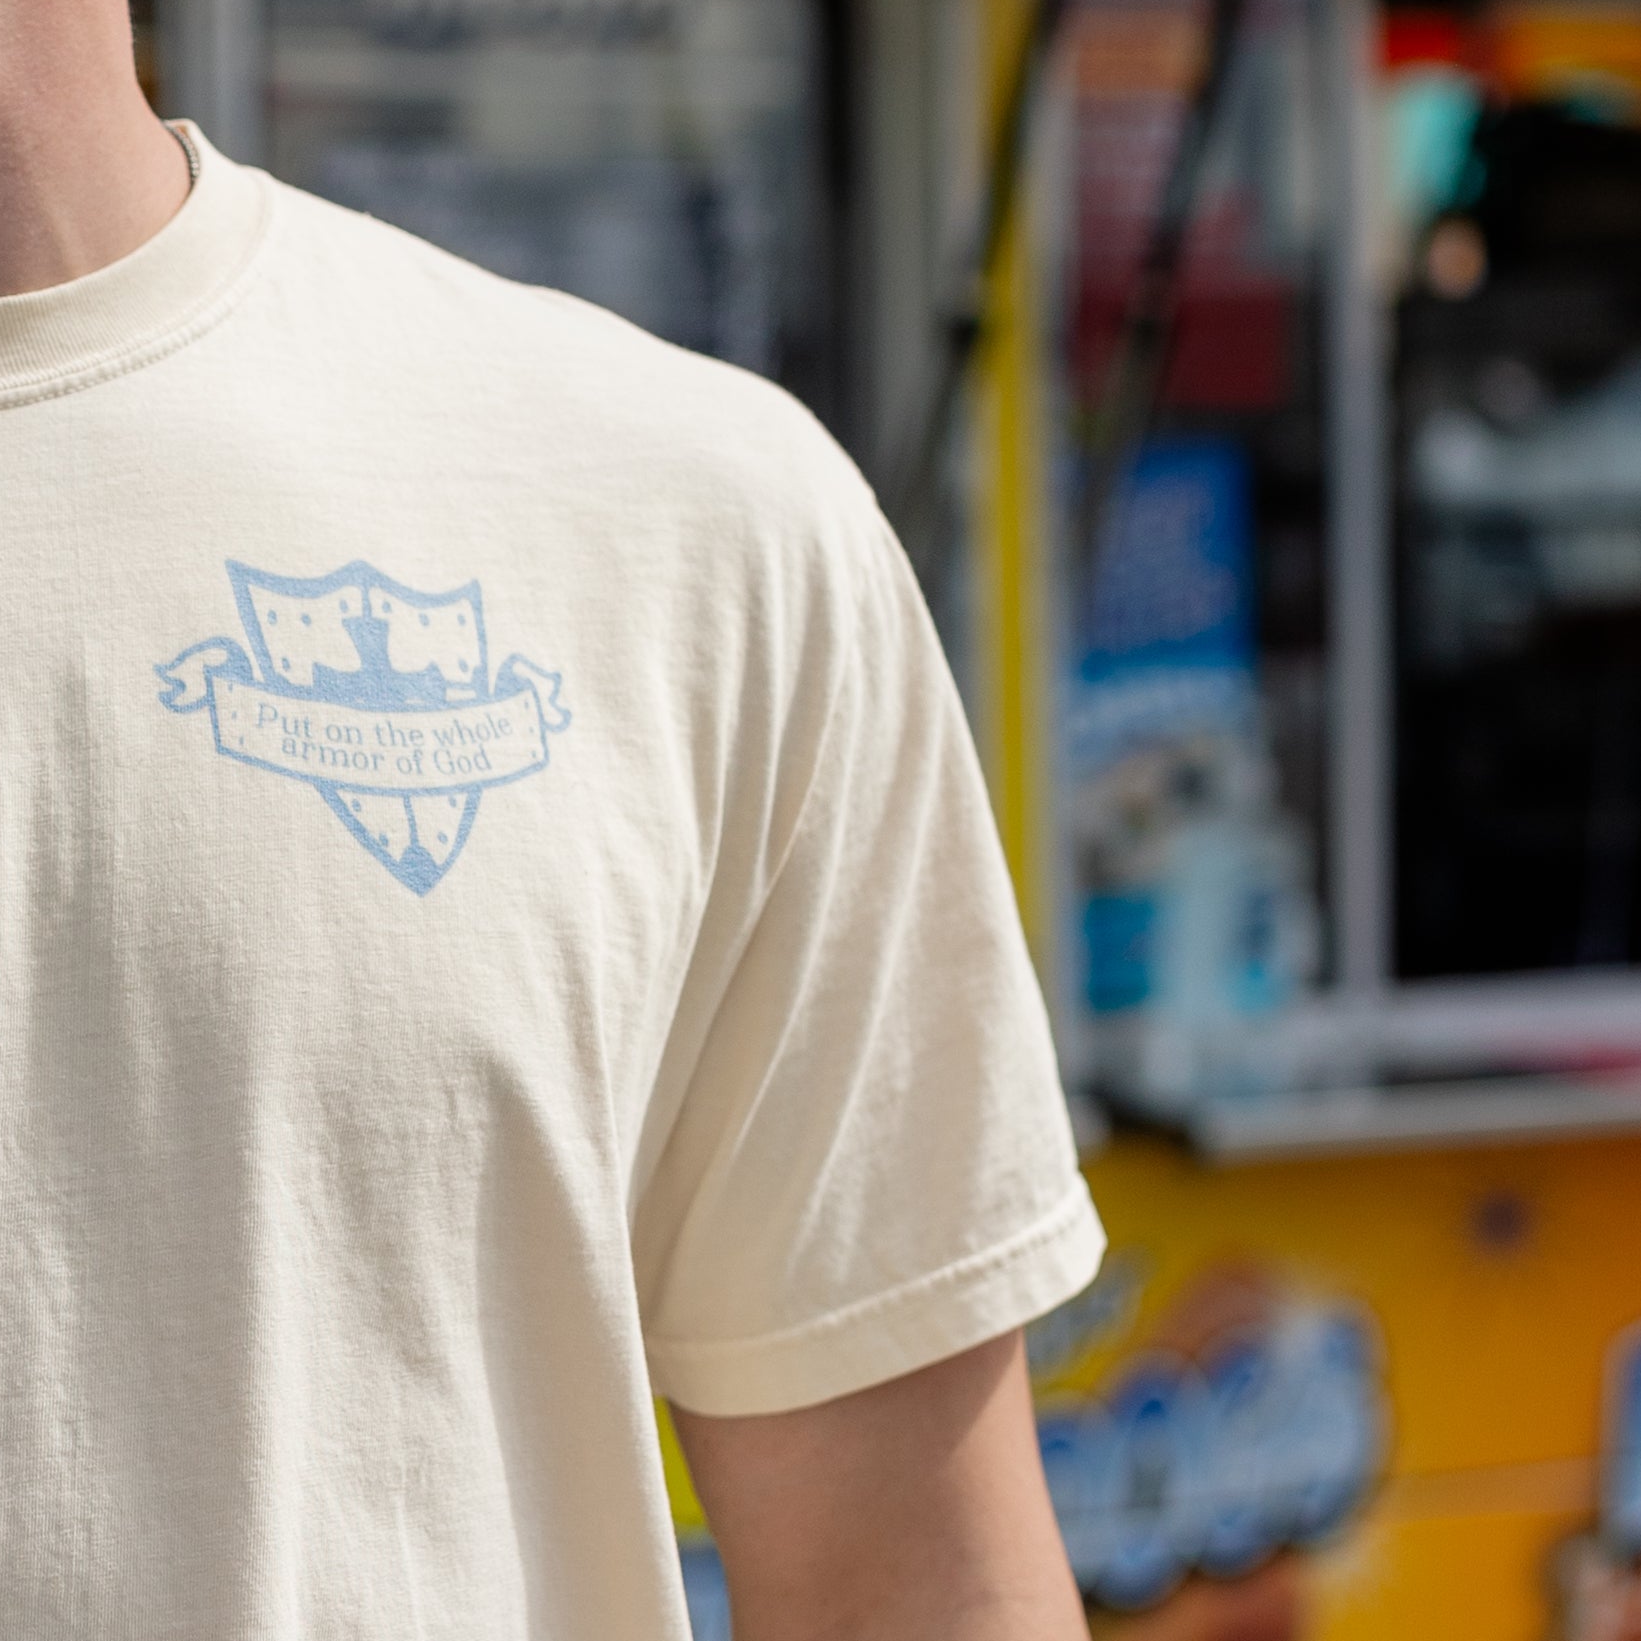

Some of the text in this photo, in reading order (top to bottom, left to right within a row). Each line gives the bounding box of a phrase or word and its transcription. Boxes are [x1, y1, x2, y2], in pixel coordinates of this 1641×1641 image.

[256, 702, 513, 748] Put on the whole
[281, 738, 492, 776] armor of God
